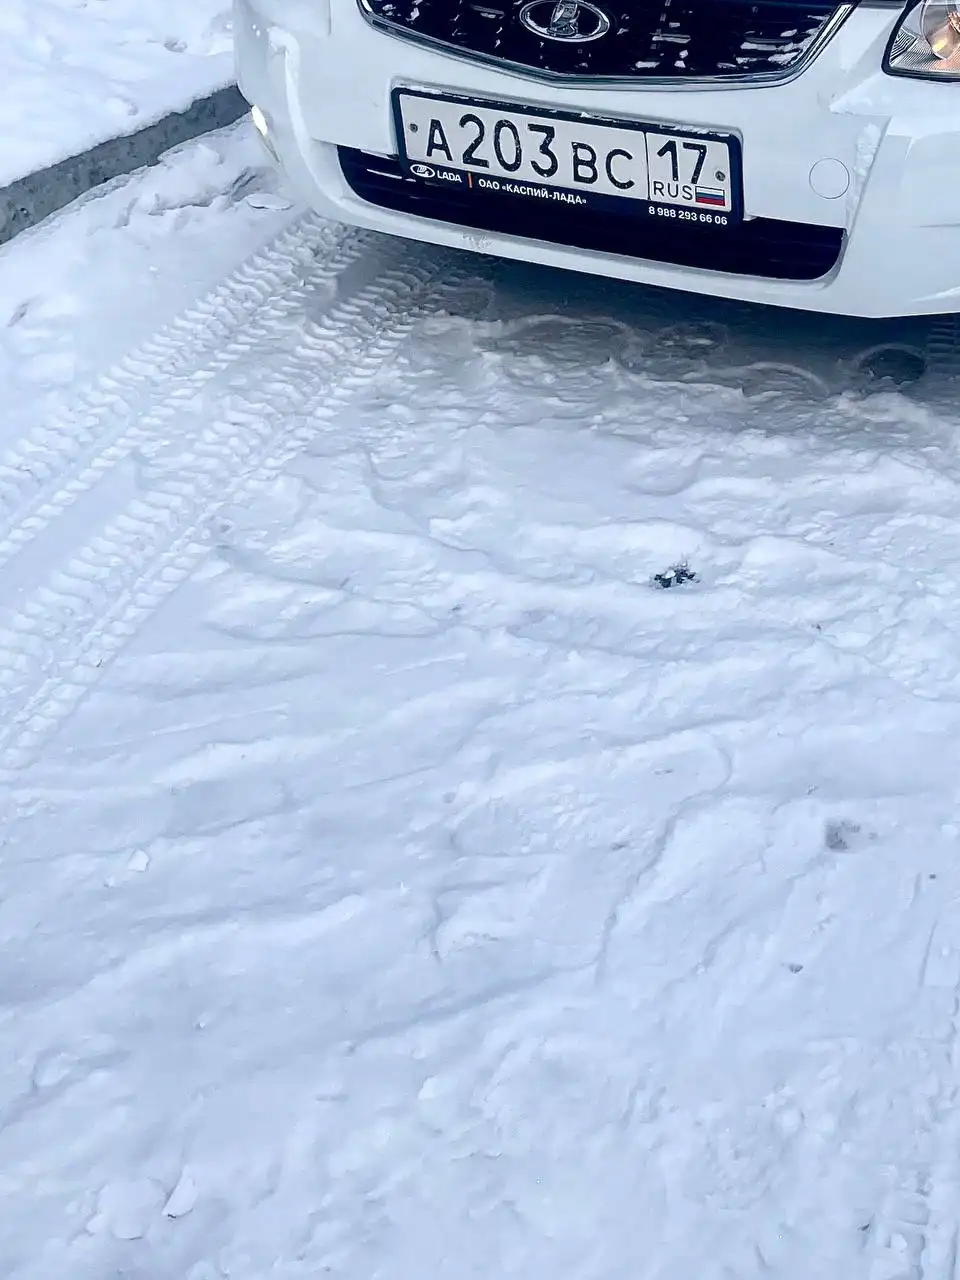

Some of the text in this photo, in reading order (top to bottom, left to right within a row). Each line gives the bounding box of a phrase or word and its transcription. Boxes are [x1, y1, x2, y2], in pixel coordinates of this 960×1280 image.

[656, 139, 708, 186] 17
[436, 170, 463, 184] LADA
[478, 178, 500, 191] ОАО
[653, 181, 693, 201] RUS
[648, 206, 728, 226] 8 988 293 66 06
